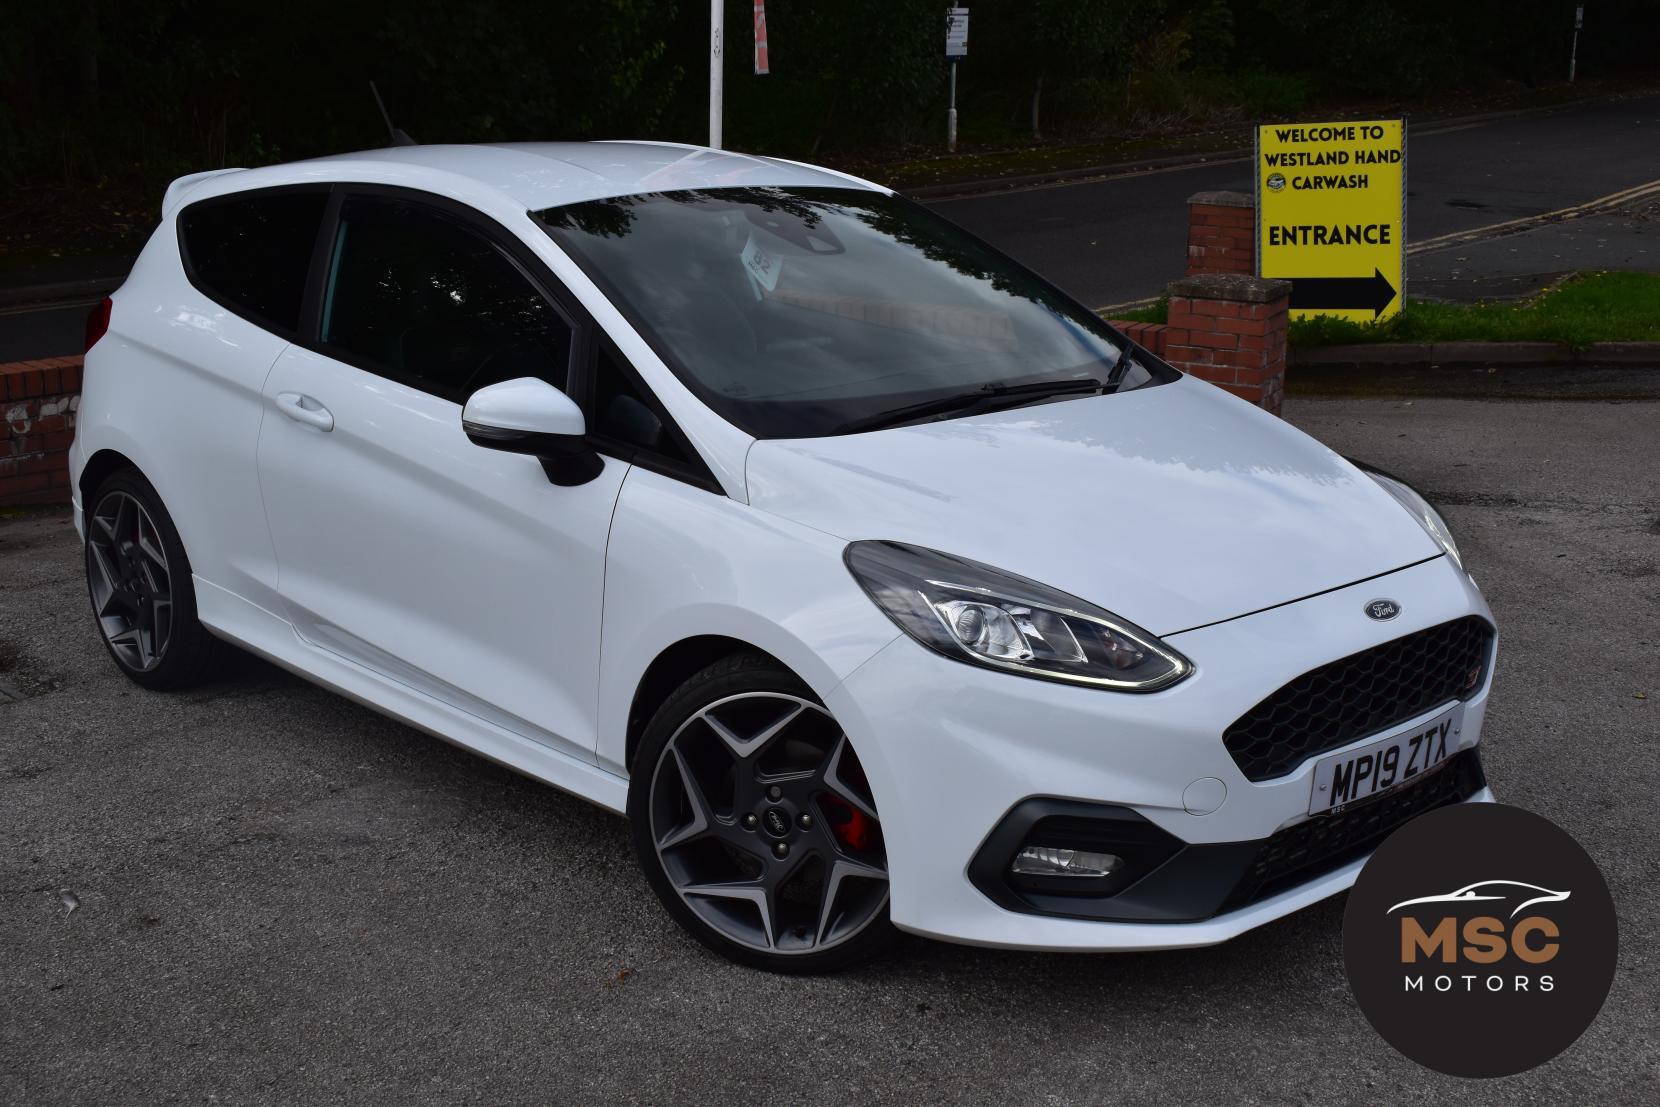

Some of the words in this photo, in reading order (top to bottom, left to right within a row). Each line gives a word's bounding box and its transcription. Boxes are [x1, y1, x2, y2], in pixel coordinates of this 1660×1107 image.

[1276, 126, 1355, 143] WELCOME
[1360, 126, 1384, 140] TO
[1265, 151, 1349, 167] WESTLAND
[1355, 150, 1401, 165] HAND
[1292, 175, 1368, 190] CARWASH
[1269, 224, 1391, 246] ENTRANCE
[1373, 603, 1394, 617] Ford
[1330, 745, 1400, 806] MP19
[1404, 719, 1451, 779] ZTX
